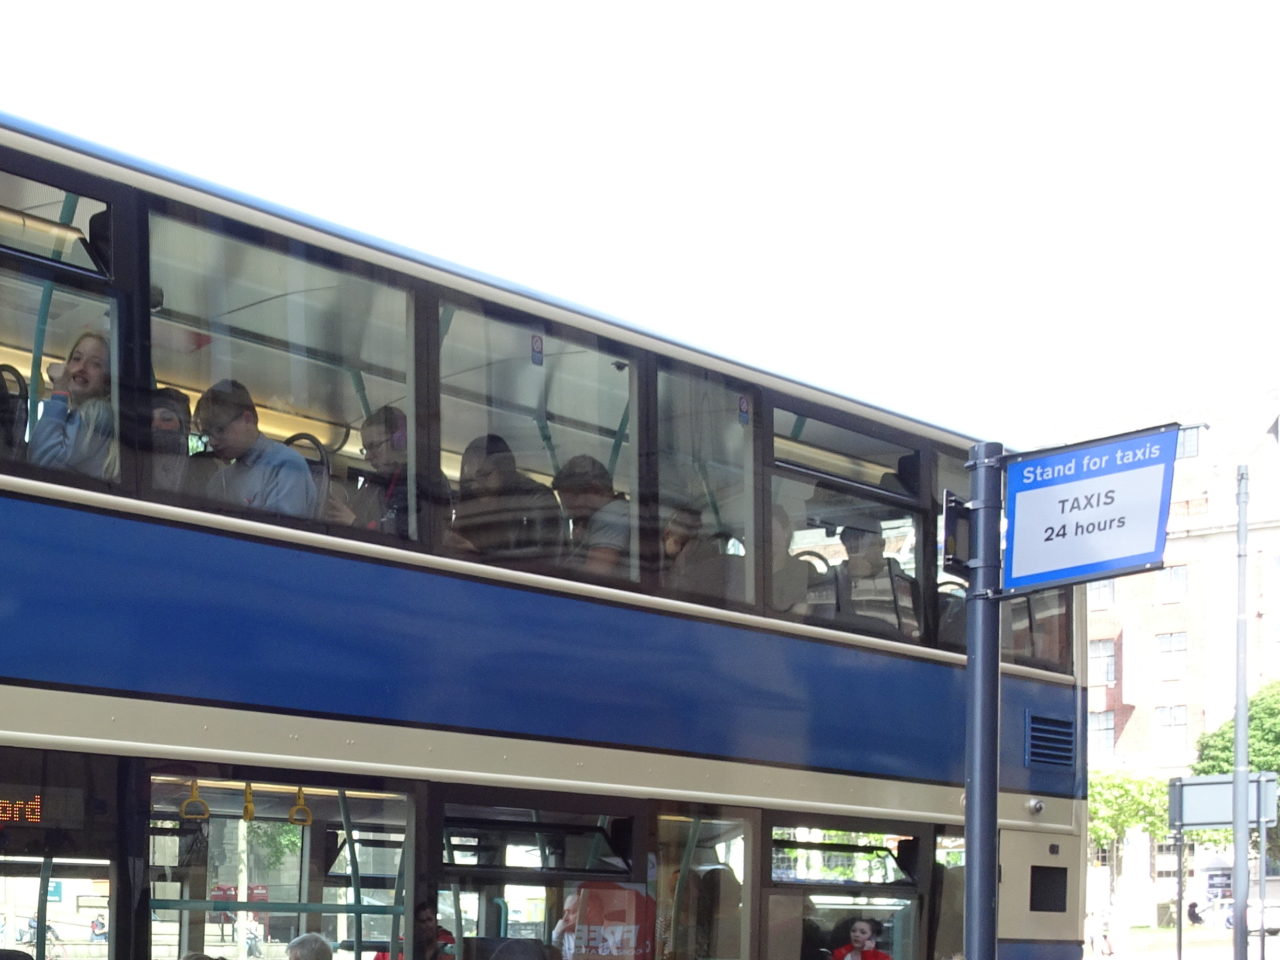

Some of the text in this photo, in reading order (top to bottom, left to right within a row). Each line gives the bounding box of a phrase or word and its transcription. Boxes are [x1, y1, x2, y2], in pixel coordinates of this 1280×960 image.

[1023, 443, 1160, 483] Stand for taxis
[1058, 489, 1116, 514] TAXIS
[1044, 516, 1125, 542] 24 hours
